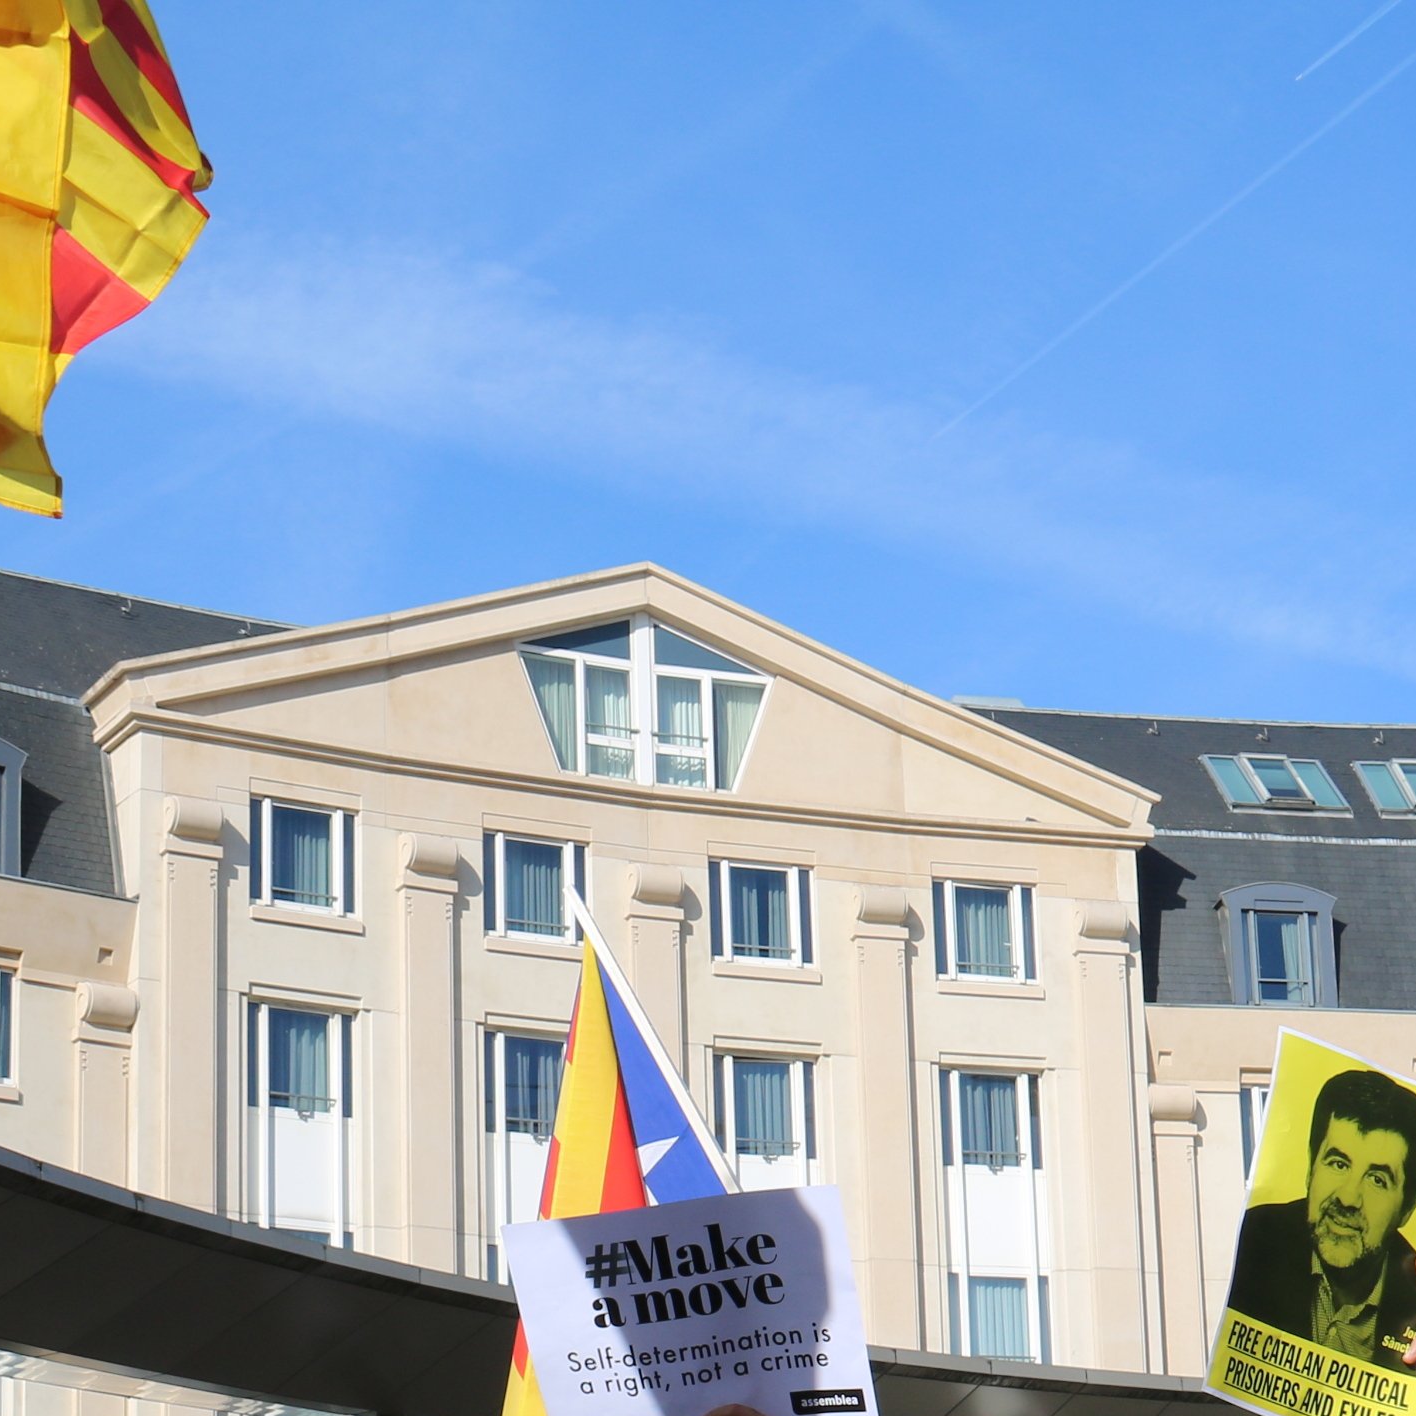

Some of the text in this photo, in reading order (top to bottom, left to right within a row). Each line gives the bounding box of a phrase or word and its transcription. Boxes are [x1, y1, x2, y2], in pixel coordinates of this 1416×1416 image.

[584, 1223, 778, 1290] #Make
[592, 1271, 786, 1329] a move
[567, 1322, 832, 1373] Self-determination is
[580, 1349, 829, 1398] a right, not a crime
[1227, 1320, 1409, 1408] FREE CATALAN POLITICAL
[800, 1394, 858, 1409] assemblea
[1224, 1356, 1301, 1408] PRISONERS
